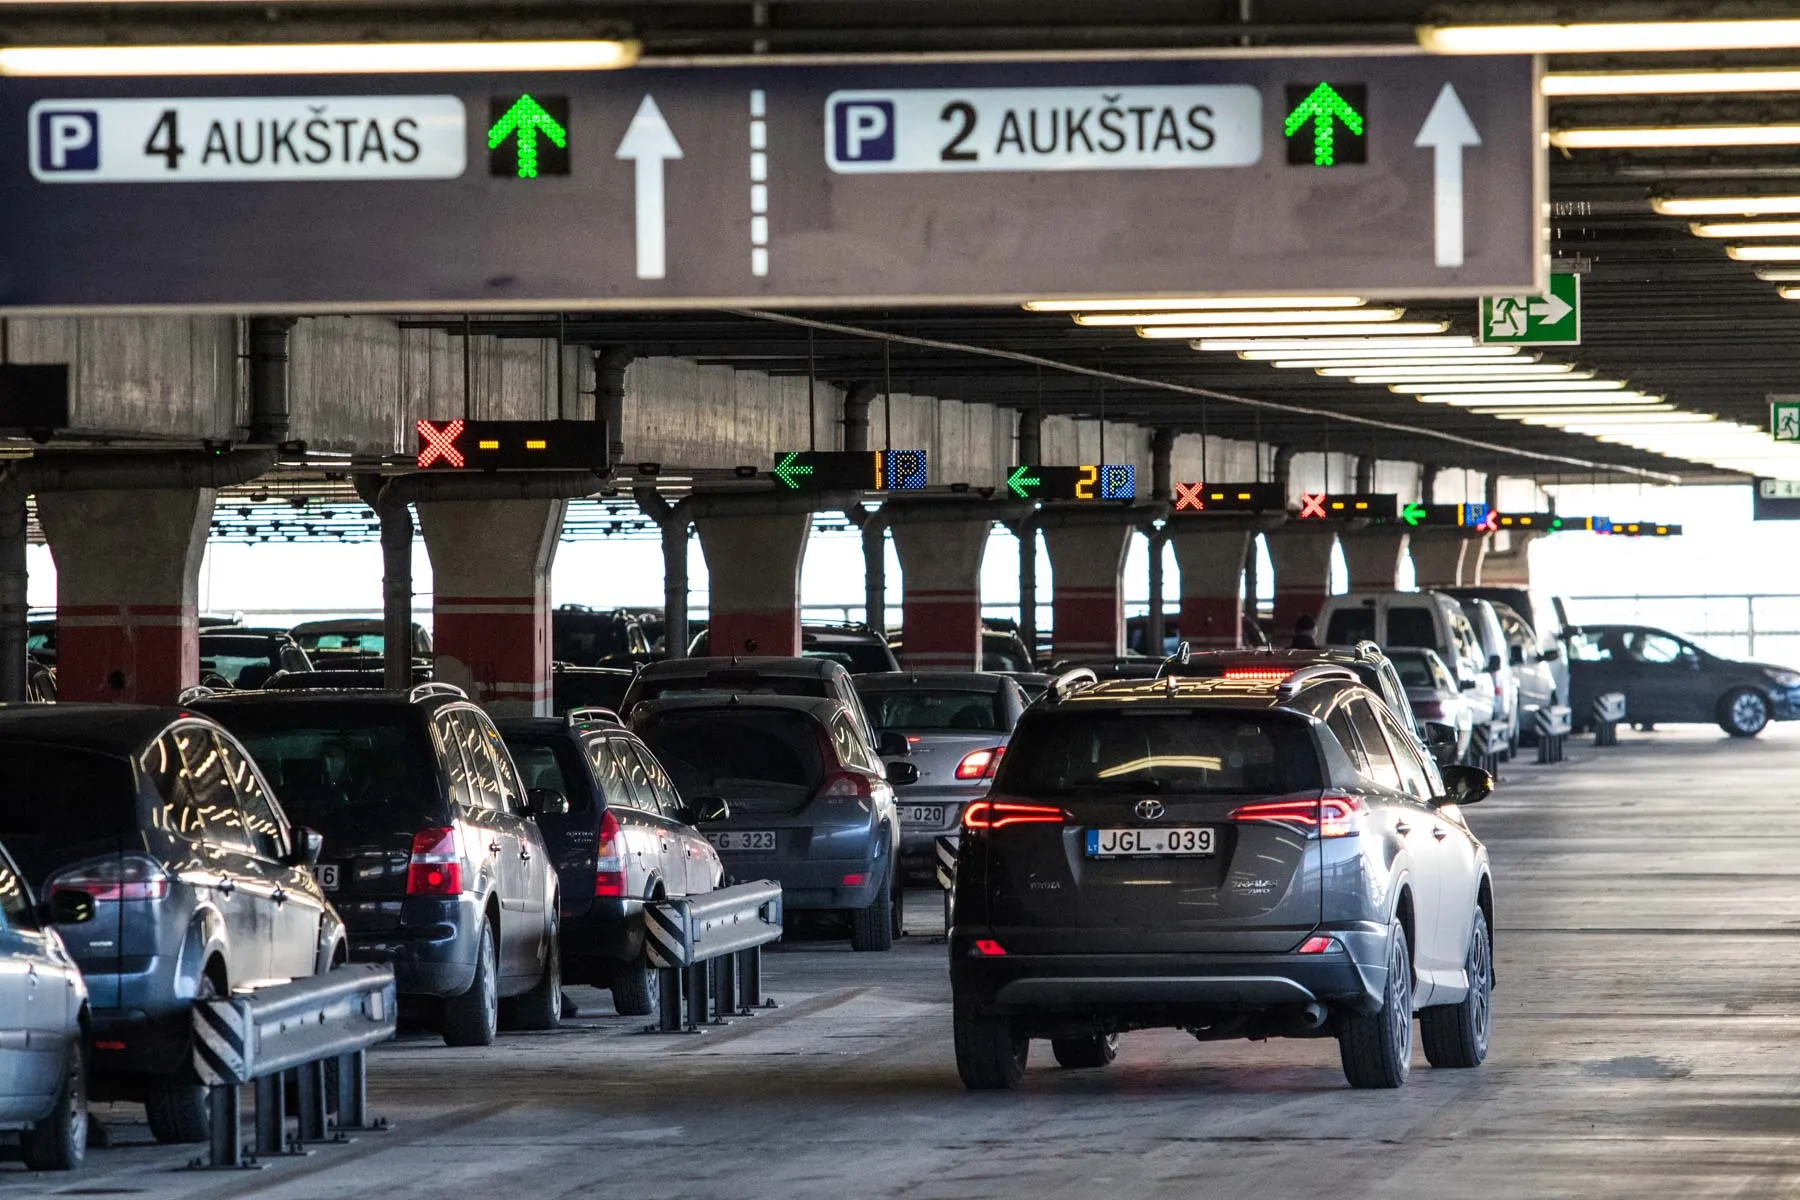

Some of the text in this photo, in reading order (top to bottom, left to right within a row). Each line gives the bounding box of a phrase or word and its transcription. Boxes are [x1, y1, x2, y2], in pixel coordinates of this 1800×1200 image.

[50, 105, 421, 170] P 4 AUKŠTAS
[846, 94, 1216, 162] P 2 AUKŠTAS
[1076, 465, 1097, 499] 2
[913, 807, 942, 821] 020
[741, 832, 774, 849] 323
[1102, 831, 1152, 852] JGL
[1168, 830, 1211, 851] 039
